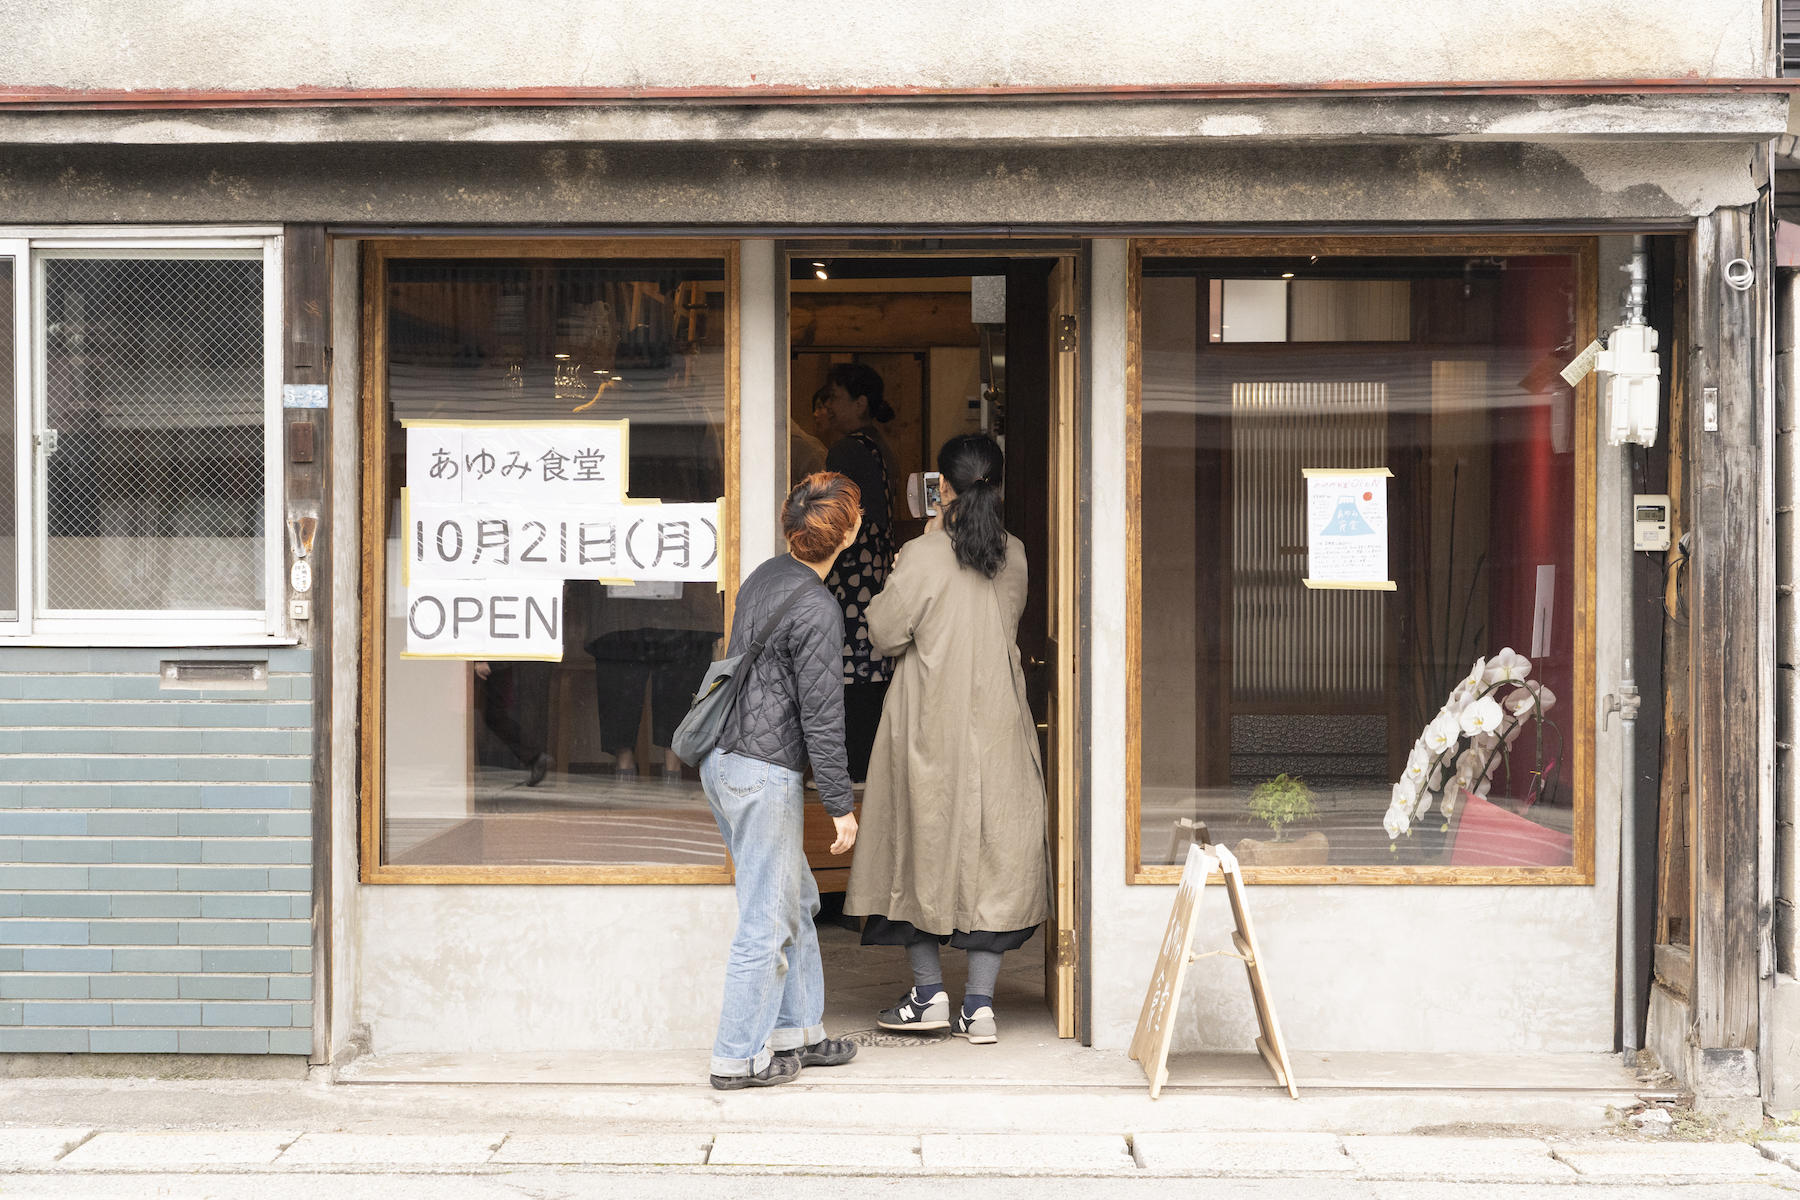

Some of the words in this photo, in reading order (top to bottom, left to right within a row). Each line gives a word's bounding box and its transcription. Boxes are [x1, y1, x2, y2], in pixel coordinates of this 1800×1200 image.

[429, 447, 606, 482] あゆみ食堂
[409, 596, 558, 640] OPEN
